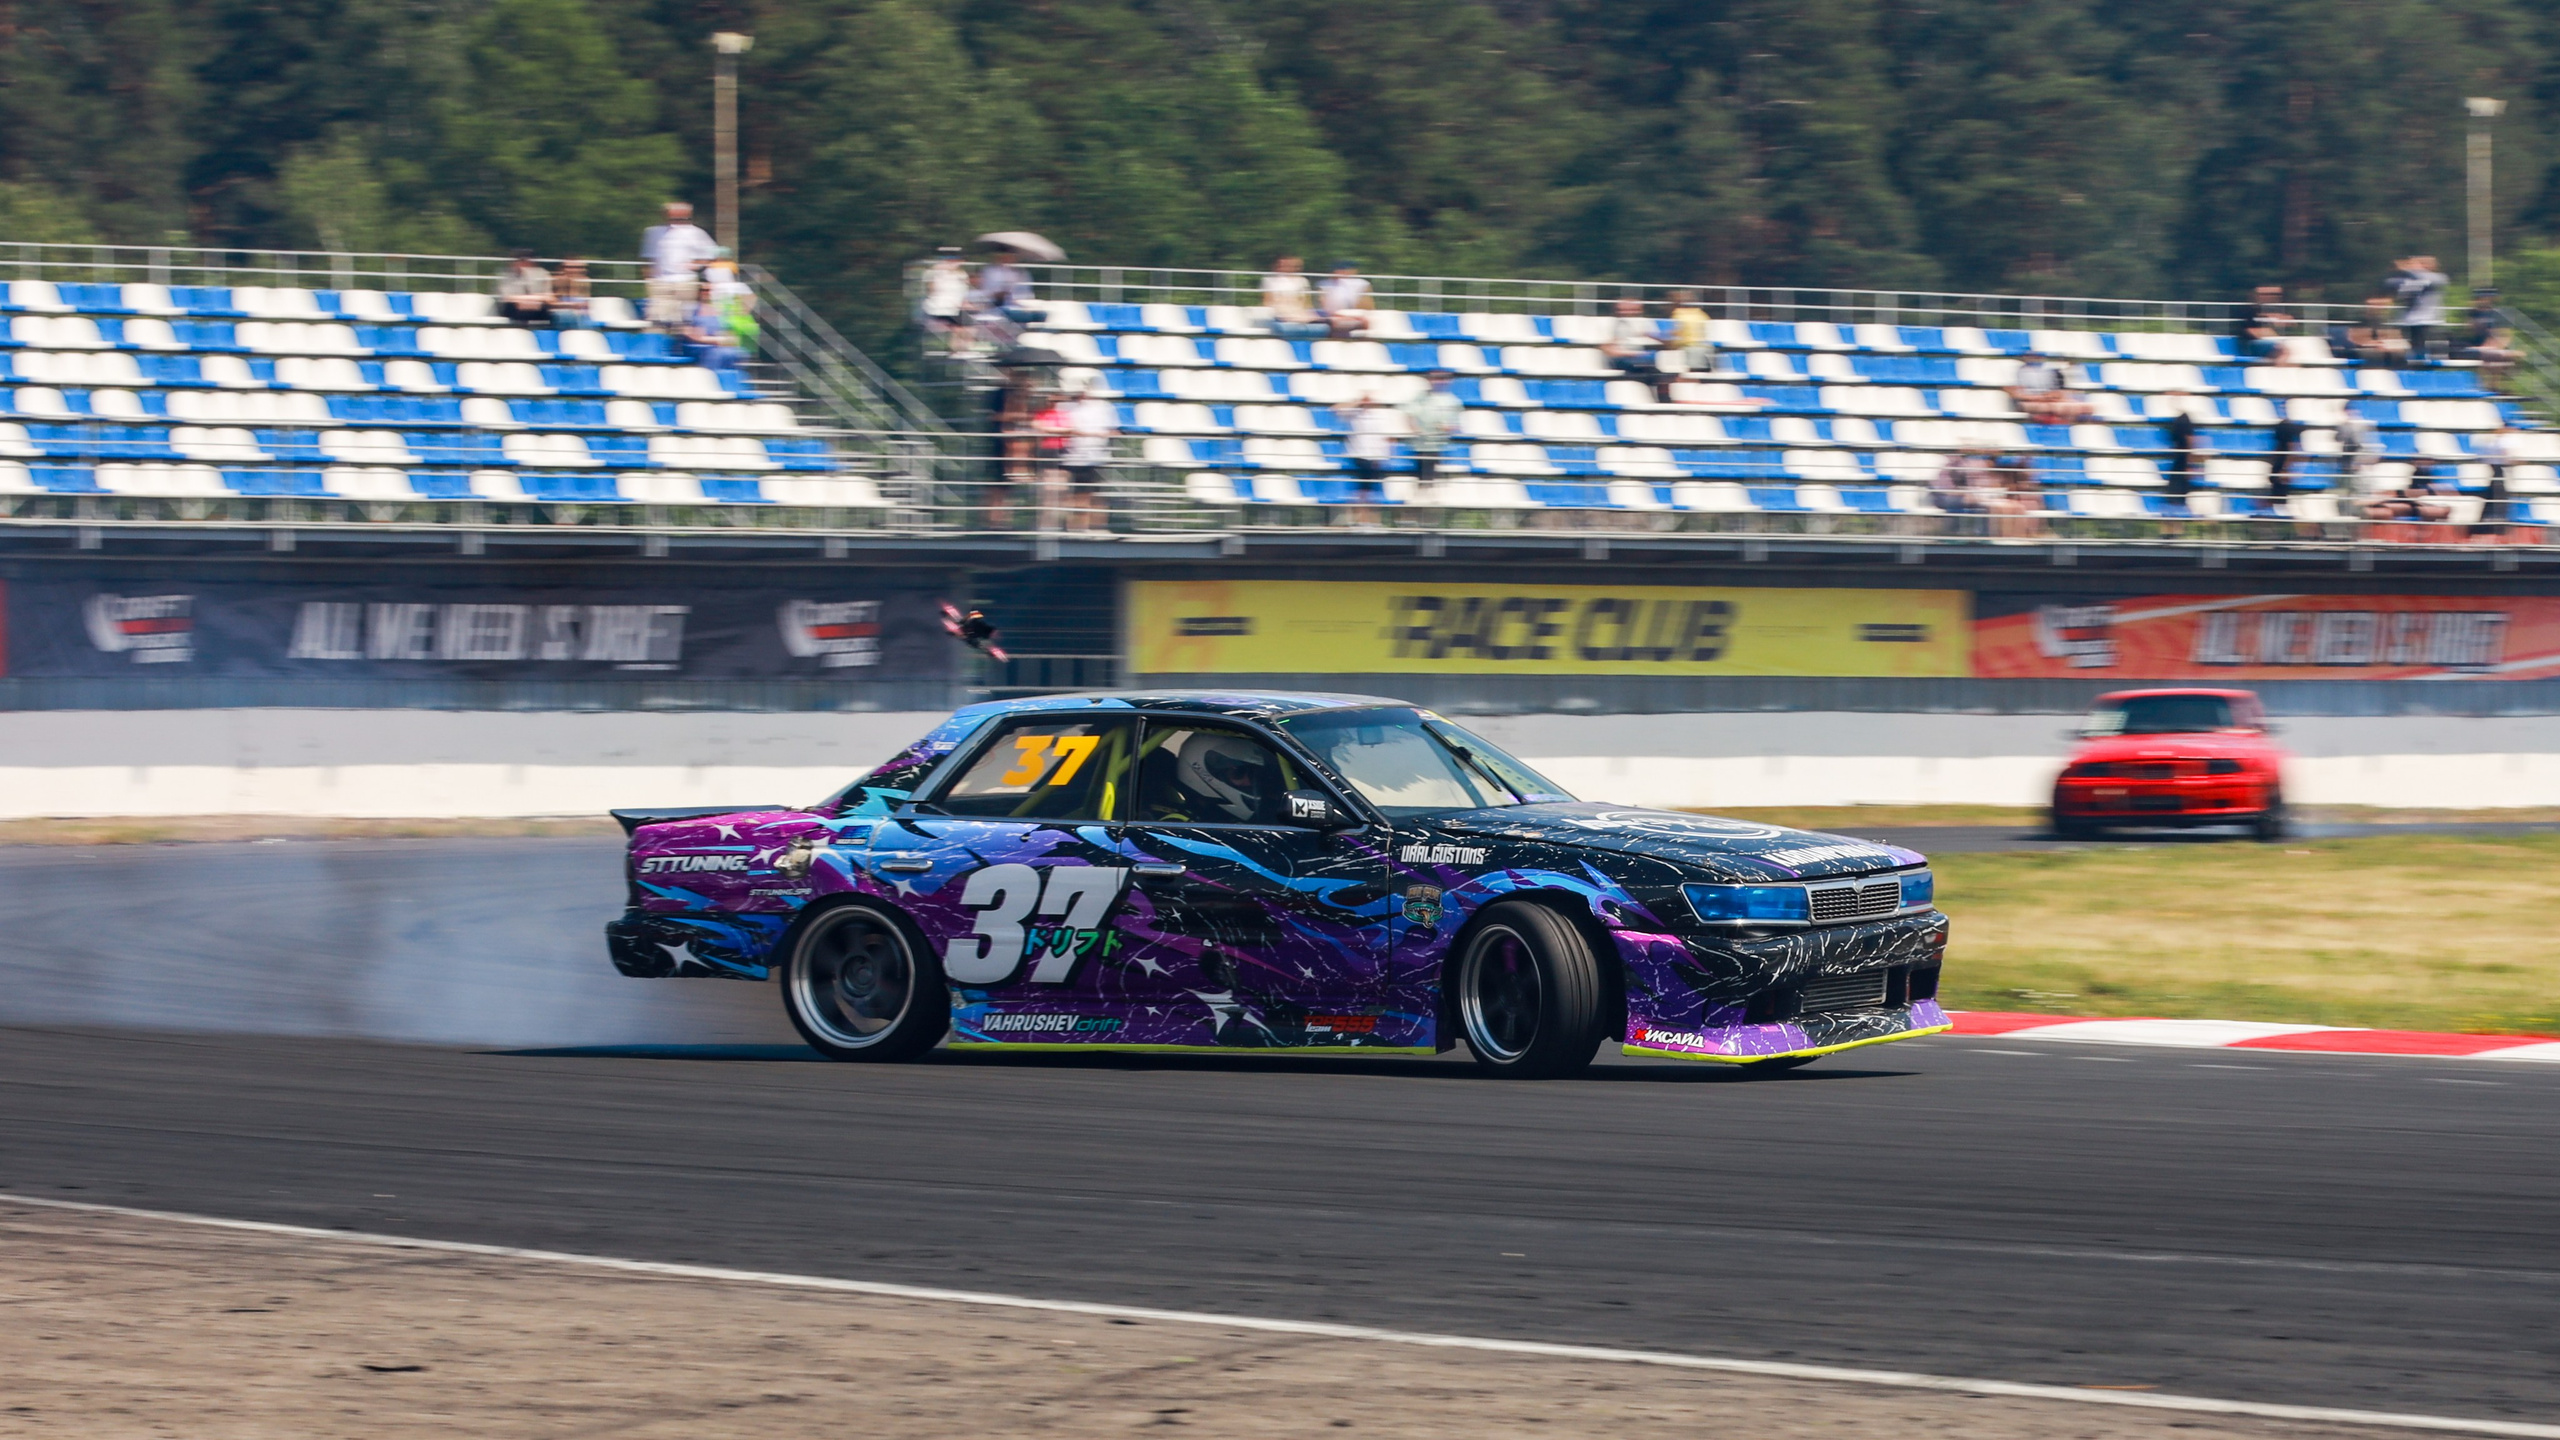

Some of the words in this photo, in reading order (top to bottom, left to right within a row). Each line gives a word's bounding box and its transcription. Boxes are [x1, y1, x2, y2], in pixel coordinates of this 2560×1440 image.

[1386, 596, 1569, 659] RACE
[1573, 598, 1741, 661] CLUB
[1001, 735, 1101, 786] 37
[943, 863, 1131, 984] 37
[1025, 927, 1123, 958] ドリフト
